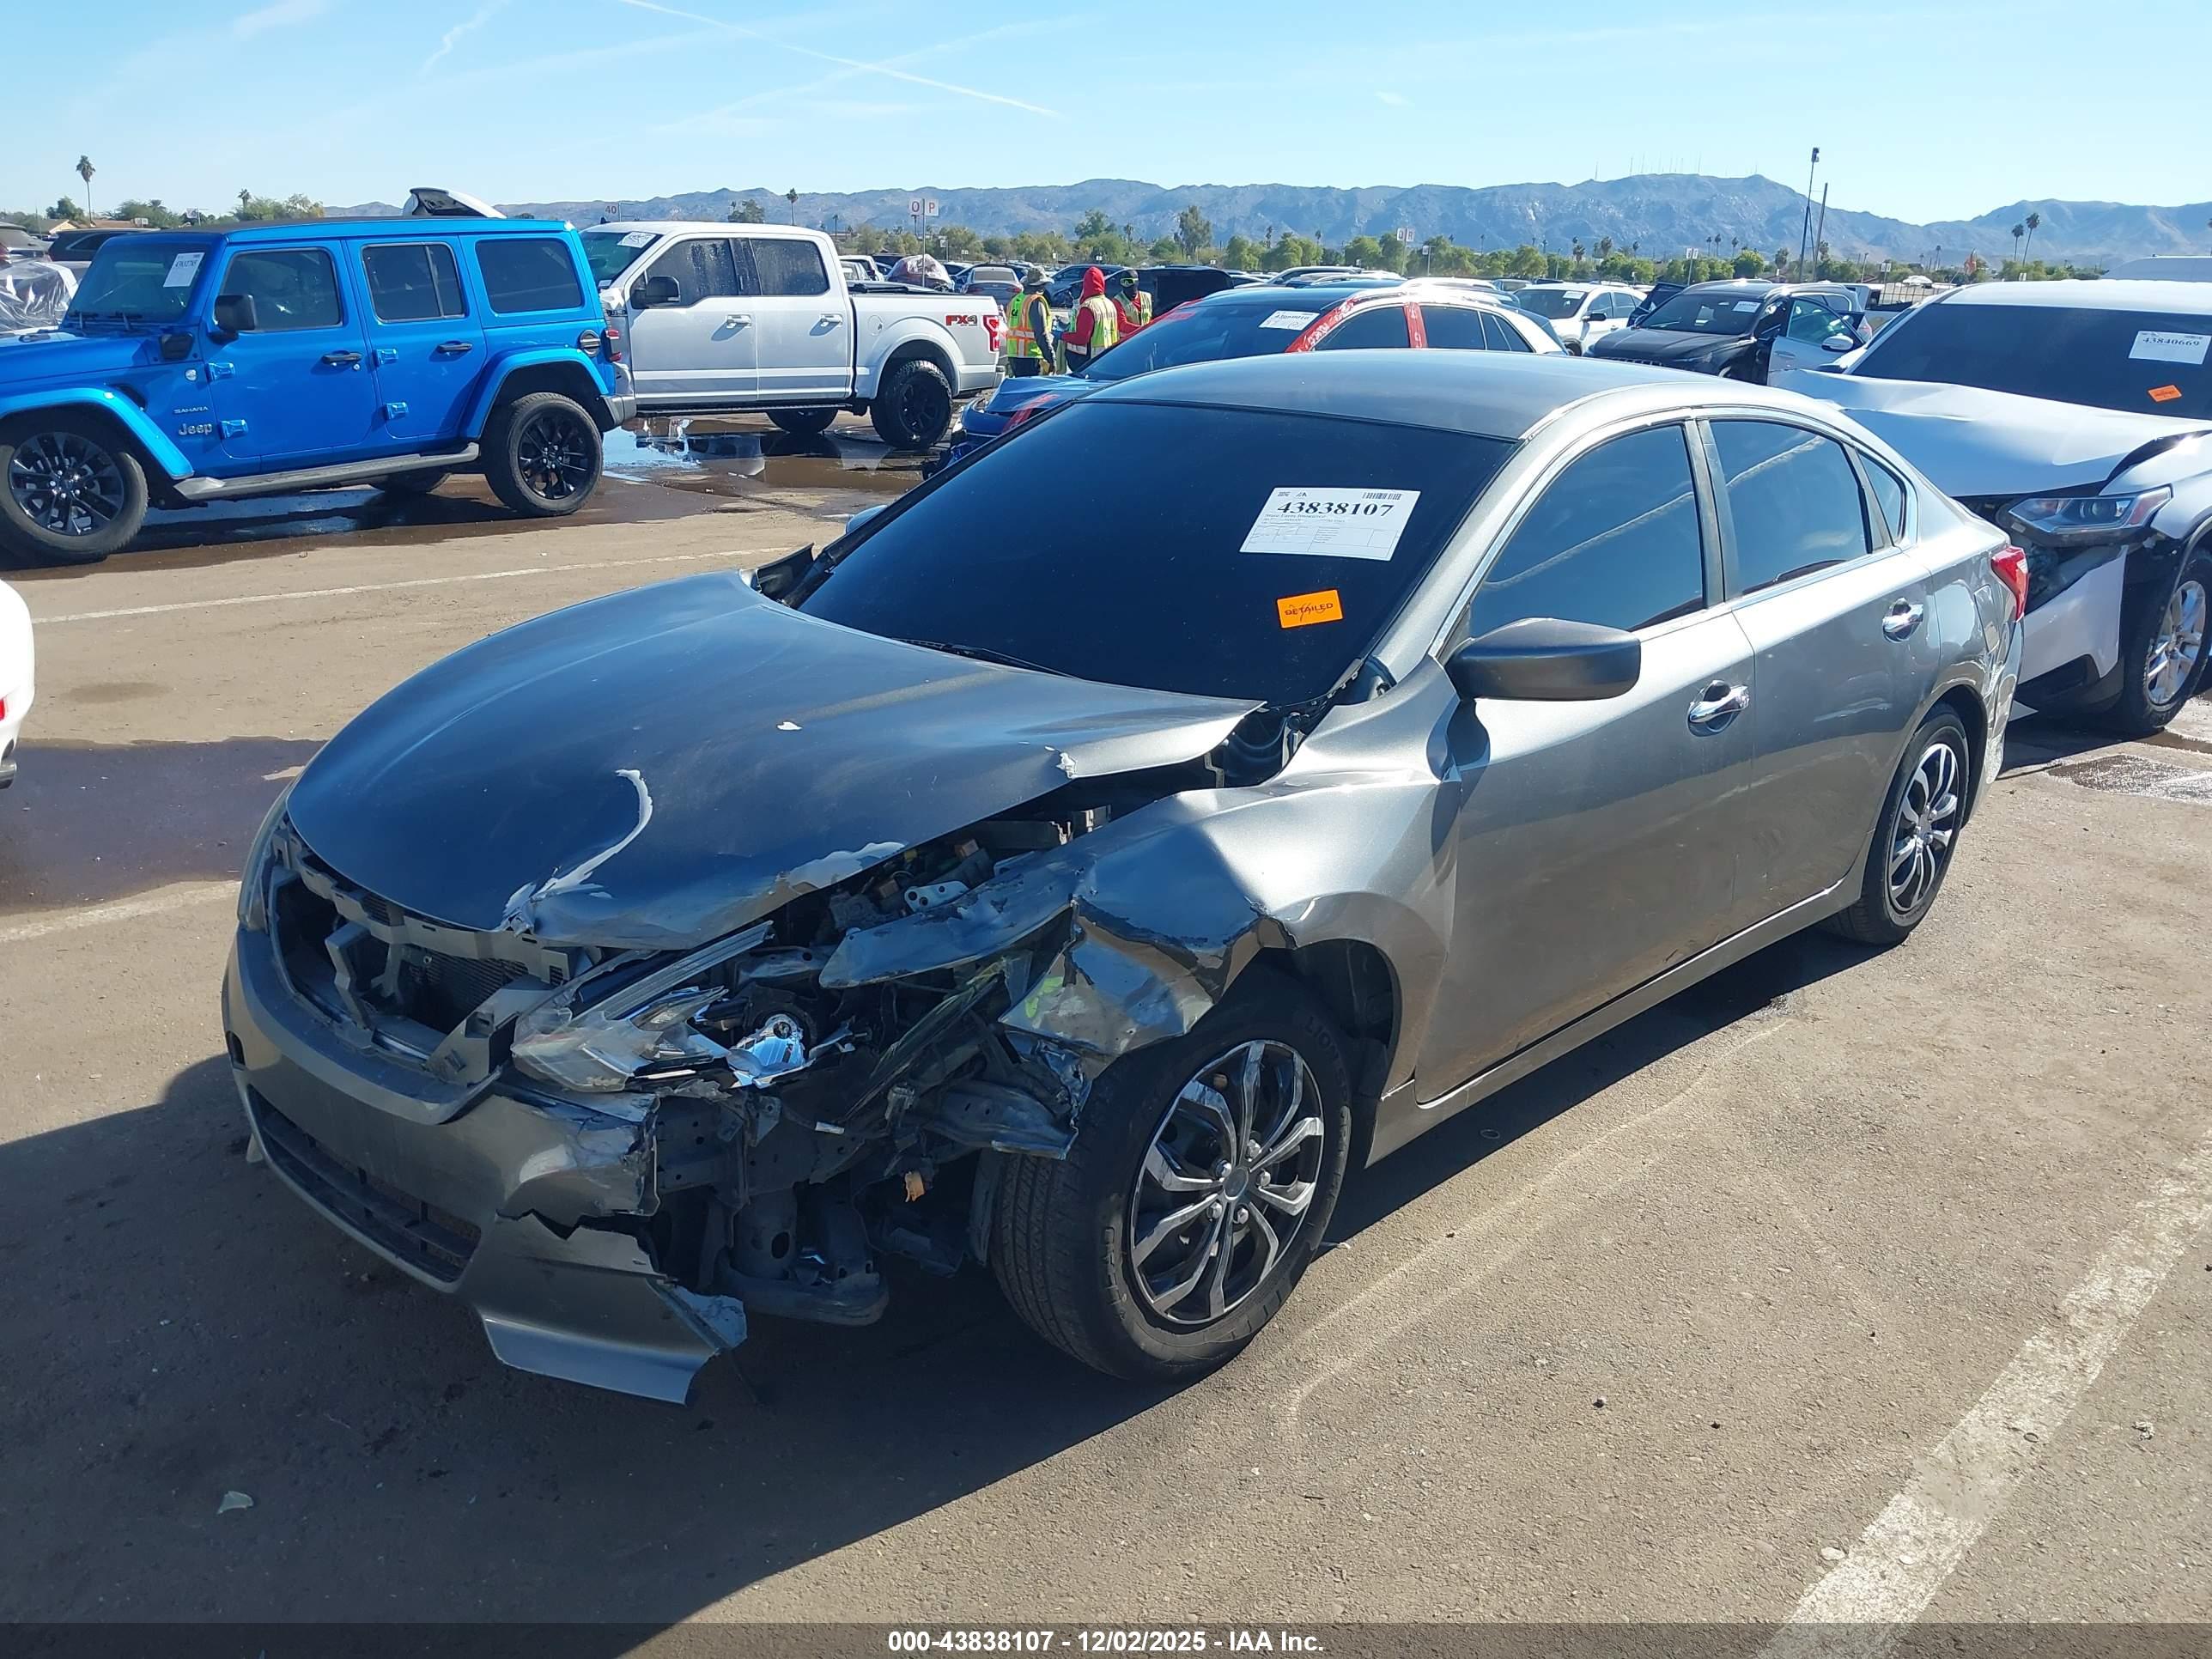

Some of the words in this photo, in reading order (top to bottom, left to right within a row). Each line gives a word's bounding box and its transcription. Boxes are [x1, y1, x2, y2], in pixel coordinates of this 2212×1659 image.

[605, 205, 617, 214] 40
[928, 202, 935, 214] P
[945, 314, 978, 326] FX4
[2143, 337, 2200, 346] 43840669
[179, 422, 213, 435] Jeep
[1277, 501, 1395, 517] 43838107
[1284, 603, 1334, 616] DETAILED
